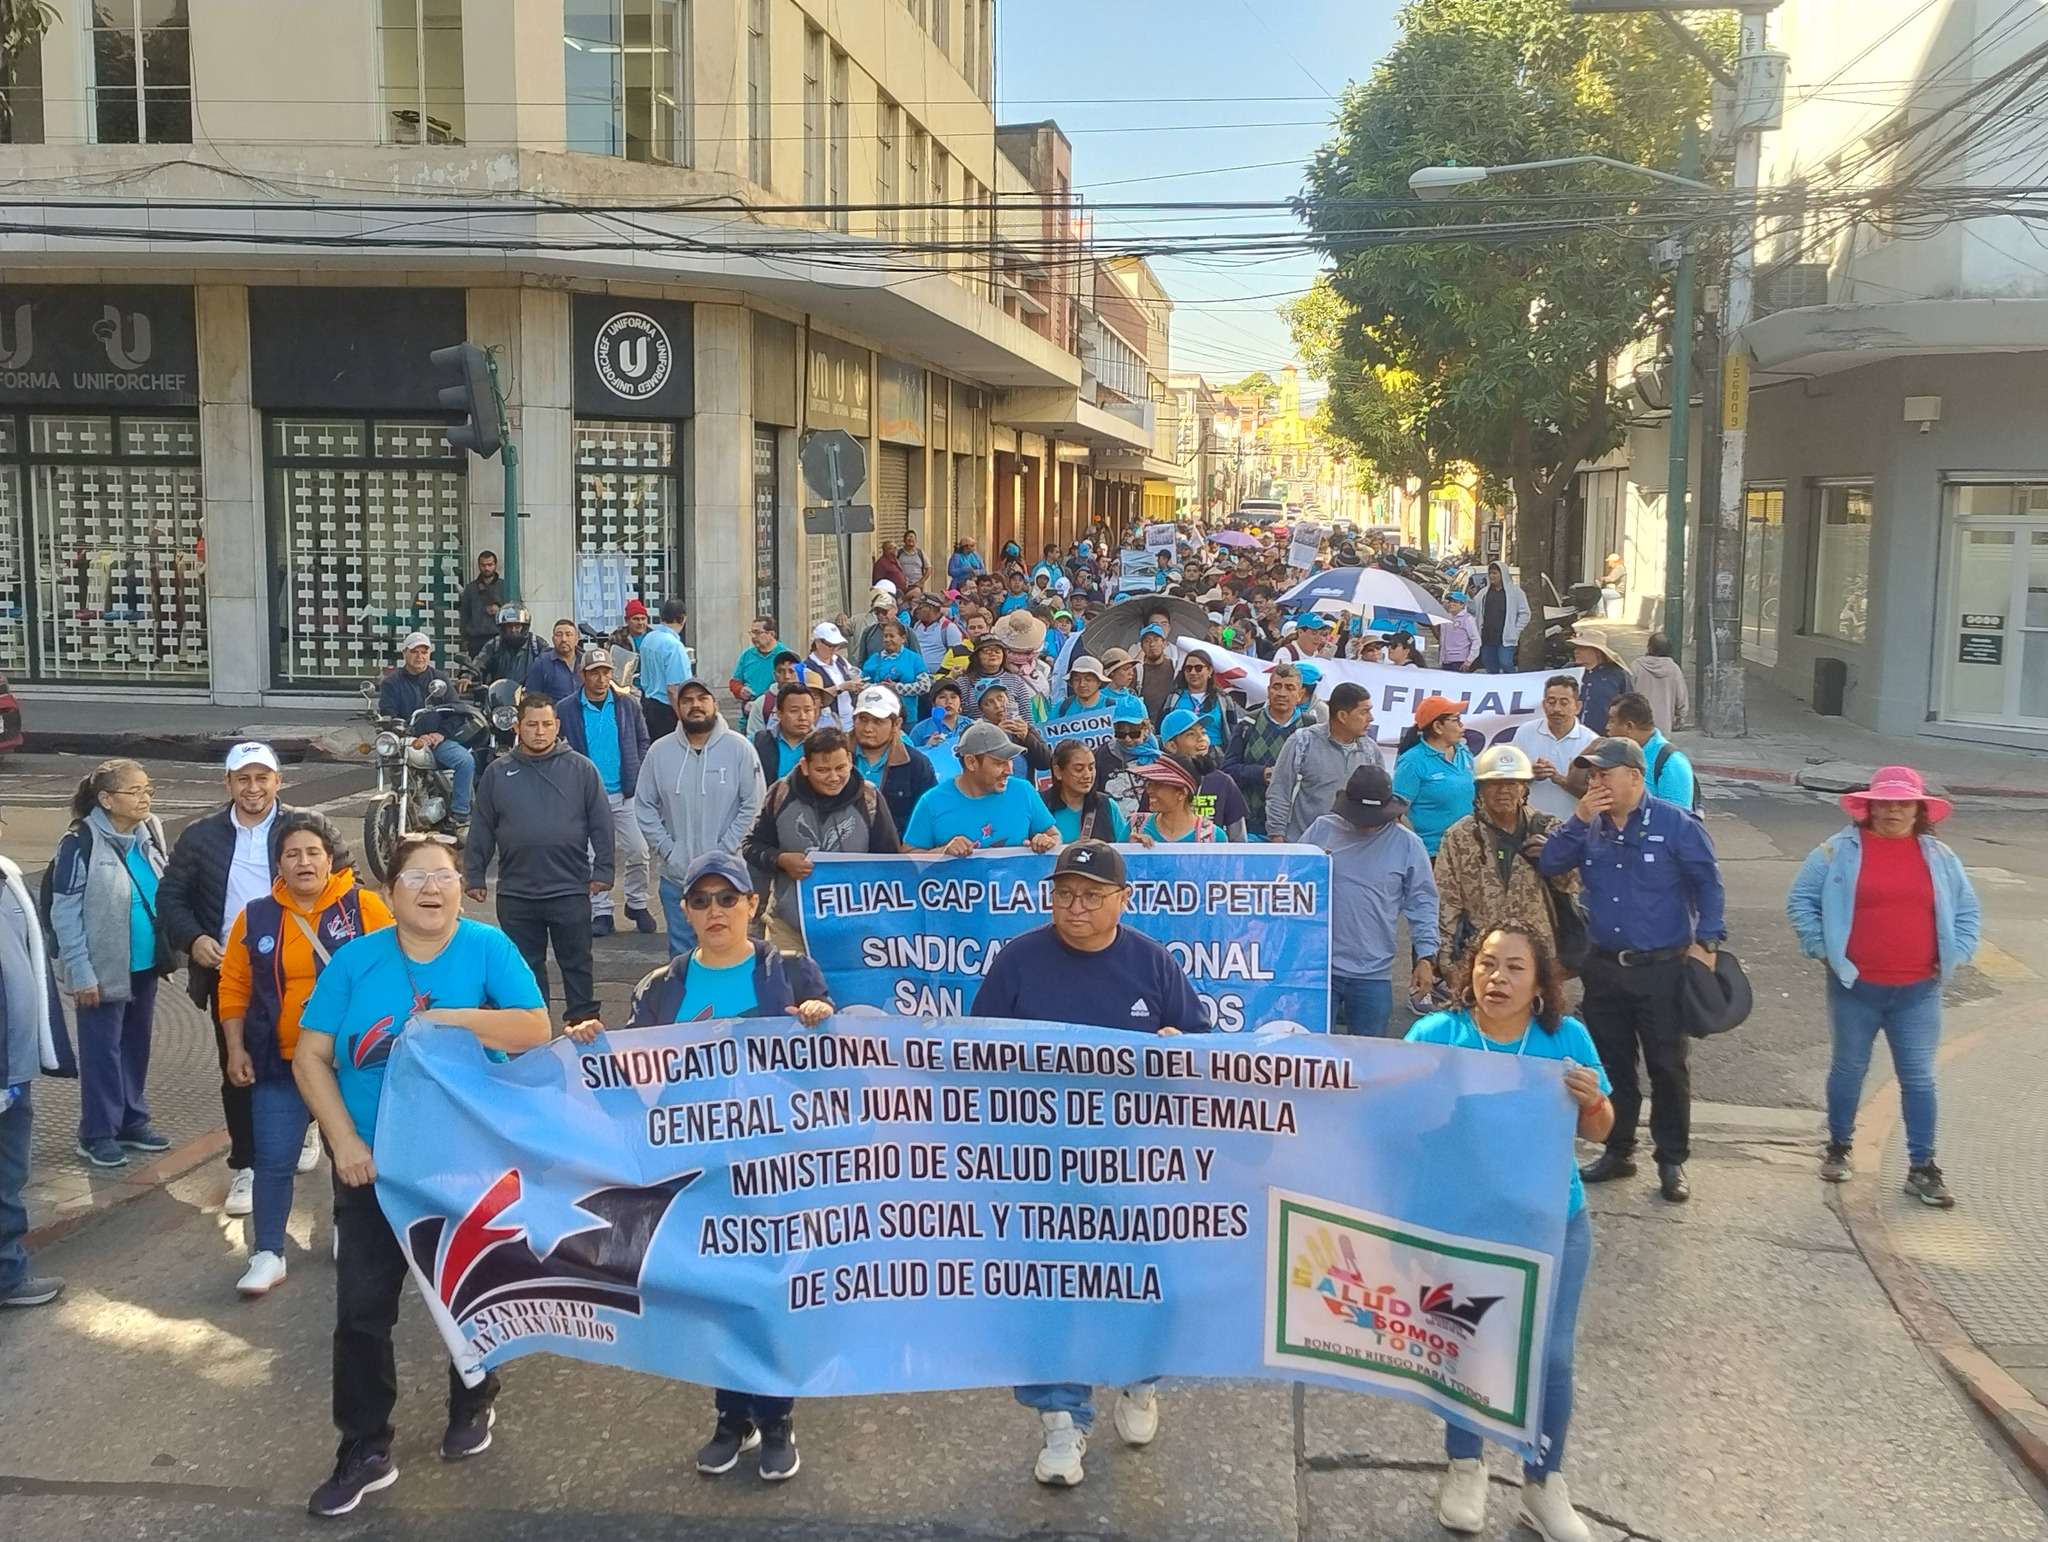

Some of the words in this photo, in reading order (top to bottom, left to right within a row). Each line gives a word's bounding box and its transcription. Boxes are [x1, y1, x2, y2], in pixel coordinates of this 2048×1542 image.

[607, 317, 657, 338] UNIFORMA
[73, 372, 186, 390] UNIFORCHEF
[599, 336, 634, 394] UNIFORCHEF
[637, 339, 668, 393] UNIFORMED
[1382, 685, 1535, 715] FIIAL
[1193, 795, 1217, 806] ET
[815, 881, 915, 916] FILIAL
[920, 880, 985, 912] CAP
[991, 882, 1033, 912] LA
[1208, 876, 1315, 915] PETÉN
[863, 934, 1012, 976] SINDICA
[1164, 941, 1275, 980] ONAL
[895, 979, 963, 1017] SAN
[1198, 993, 1244, 1032] OS
[581, 1039, 736, 1090] SINDICATO
[747, 1035, 898, 1072] NACIONAL
[906, 1040, 944, 1070] DE
[953, 1042, 1135, 1076] EMPLEADOS
[1146, 1048, 1202, 1079] DEL
[1211, 1052, 1359, 1090] HOSPITAL
[649, 1097, 784, 1146] GENERAL
[792, 1088, 851, 1130] SAN
[859, 1088, 933, 1123] JUAN
[943, 1088, 980, 1122] DE
[990, 1090, 1057, 1125] DIOS
[1067, 1091, 1104, 1126] DE
[1114, 1092, 1297, 1134] GUATEMALA
[730, 1144, 901, 1197] MINISTERIO
[911, 1145, 947, 1179] DE
[957, 1146, 1051, 1181] SALUD
[1061, 1147, 1187, 1184] PUBLICA
[1194, 1148, 1215, 1182] Y
[699, 1204, 871, 1256] ASISTENCIA
[879, 1203, 983, 1238] SOCIAL
[992, 1204, 1010, 1238] Y
[1019, 1203, 1248, 1242] TRABAJADORES
[790, 1271, 826, 1310] DE
[834, 1262, 928, 1302] SALUD
[938, 1261, 974, 1297] DE
[984, 1262, 1162, 1301] GUATEMALA
[472, 1332, 498, 1358] AN
[501, 1316, 546, 1342] JUAN
[548, 1316, 573, 1336] DE
[576, 1320, 616, 1343] DIOS
[474, 1301, 594, 1331] SINDICATO
[1373, 1314, 1460, 1359] SOMOS
[1304, 1336, 1342, 1352] BONO
[1345, 1343, 1362, 1356] DE
[1364, 1349, 1414, 1369] RIESGO
[1373, 1331, 1457, 1375] TODOS
